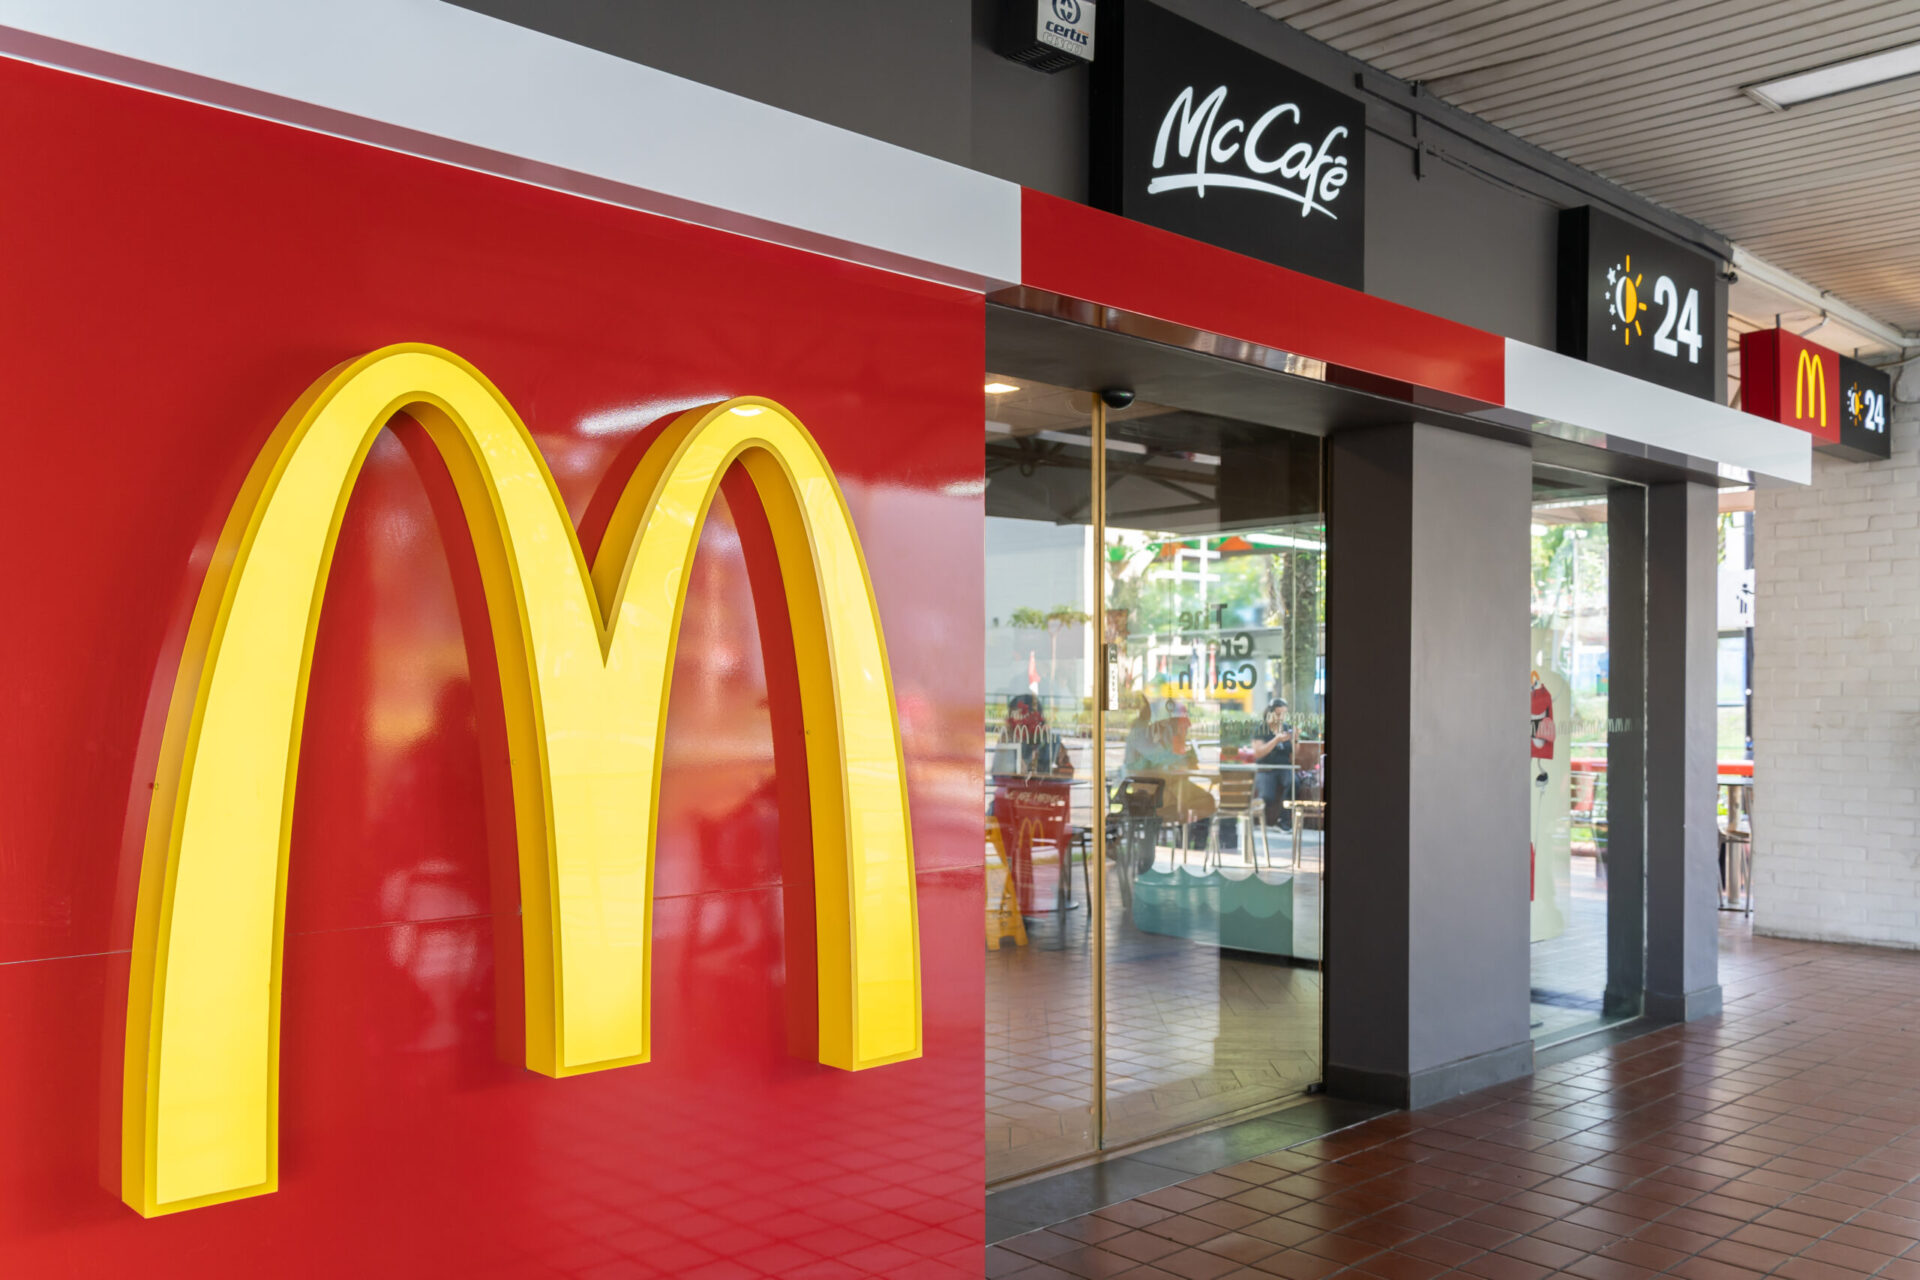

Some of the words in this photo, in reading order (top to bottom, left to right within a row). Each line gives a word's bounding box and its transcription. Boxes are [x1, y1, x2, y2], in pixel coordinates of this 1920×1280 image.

[1045, 20, 1089, 45] certis
[1148, 85, 1348, 219] McCafé
[1653, 275, 1703, 364] 24
[1864, 389, 1885, 434] 24
